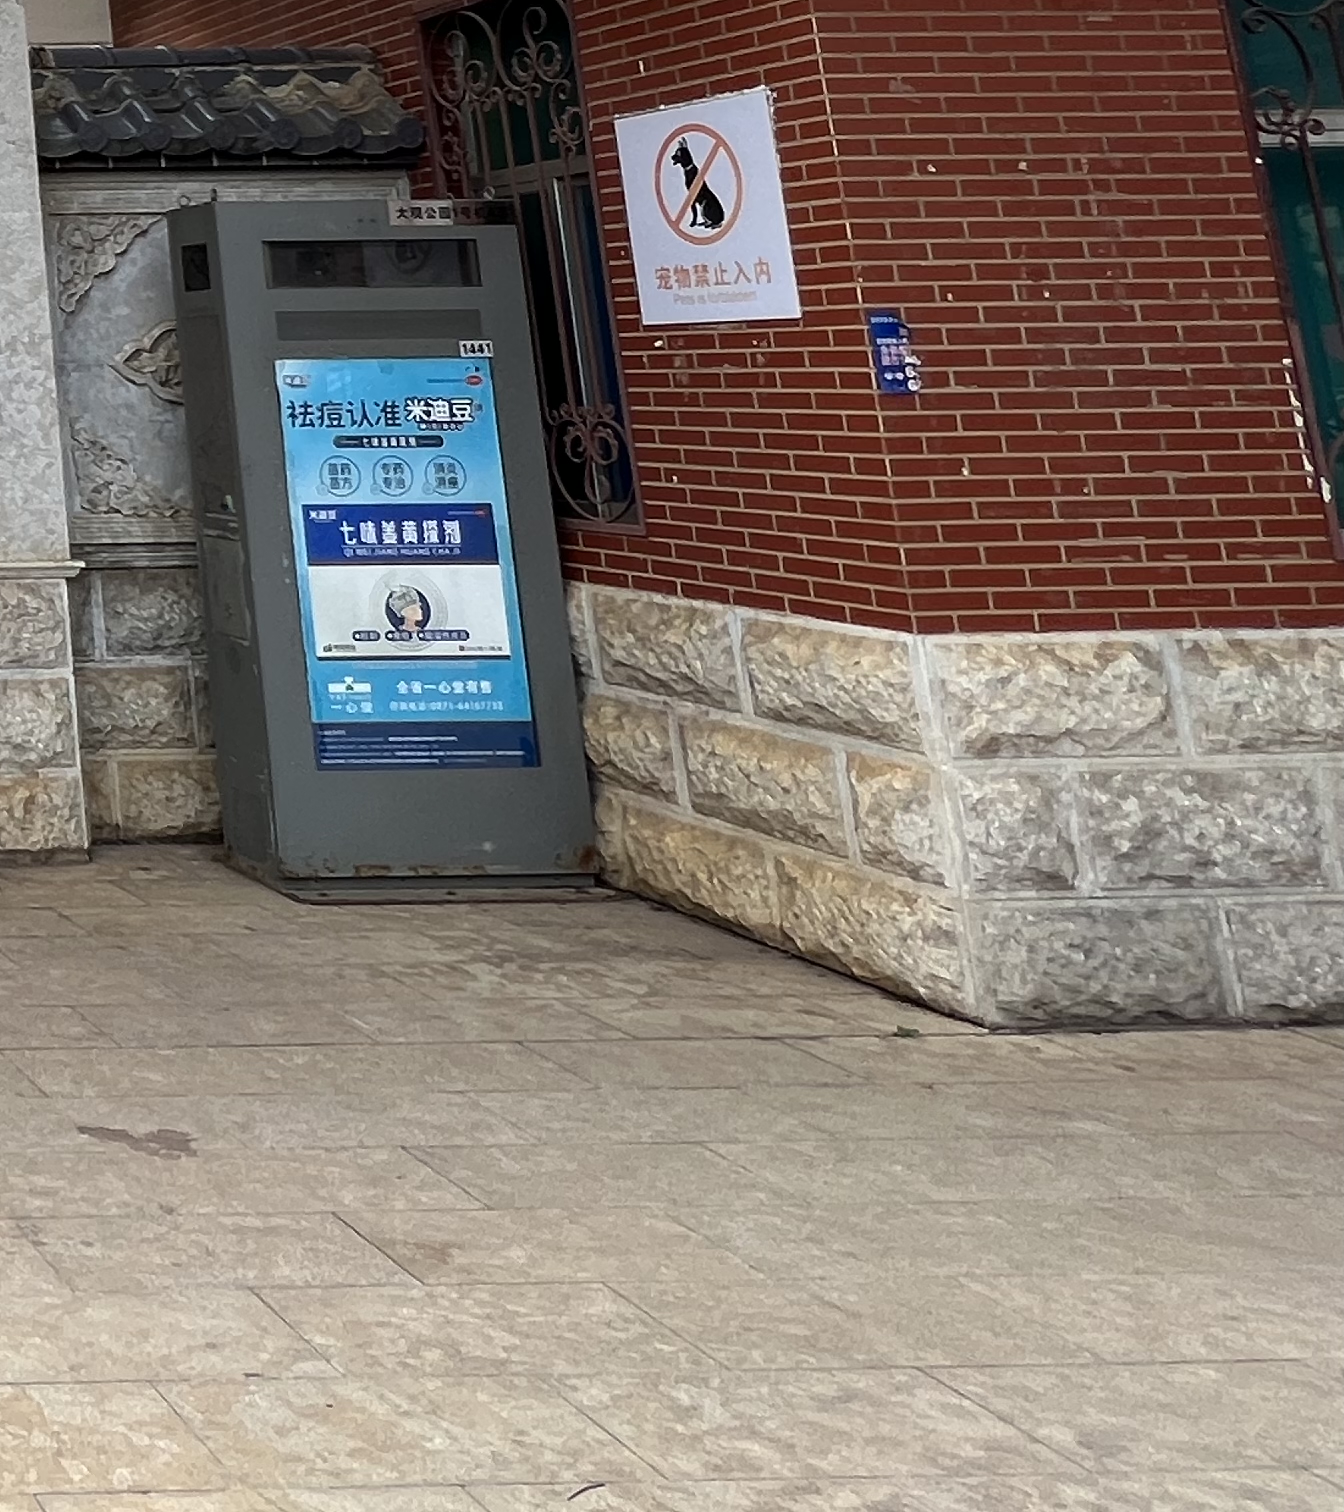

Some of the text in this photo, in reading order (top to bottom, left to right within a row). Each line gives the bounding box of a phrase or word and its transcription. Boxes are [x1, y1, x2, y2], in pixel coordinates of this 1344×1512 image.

[654, 256, 772, 290] 宠物禁止入内
[462, 343, 492, 355] 1441
